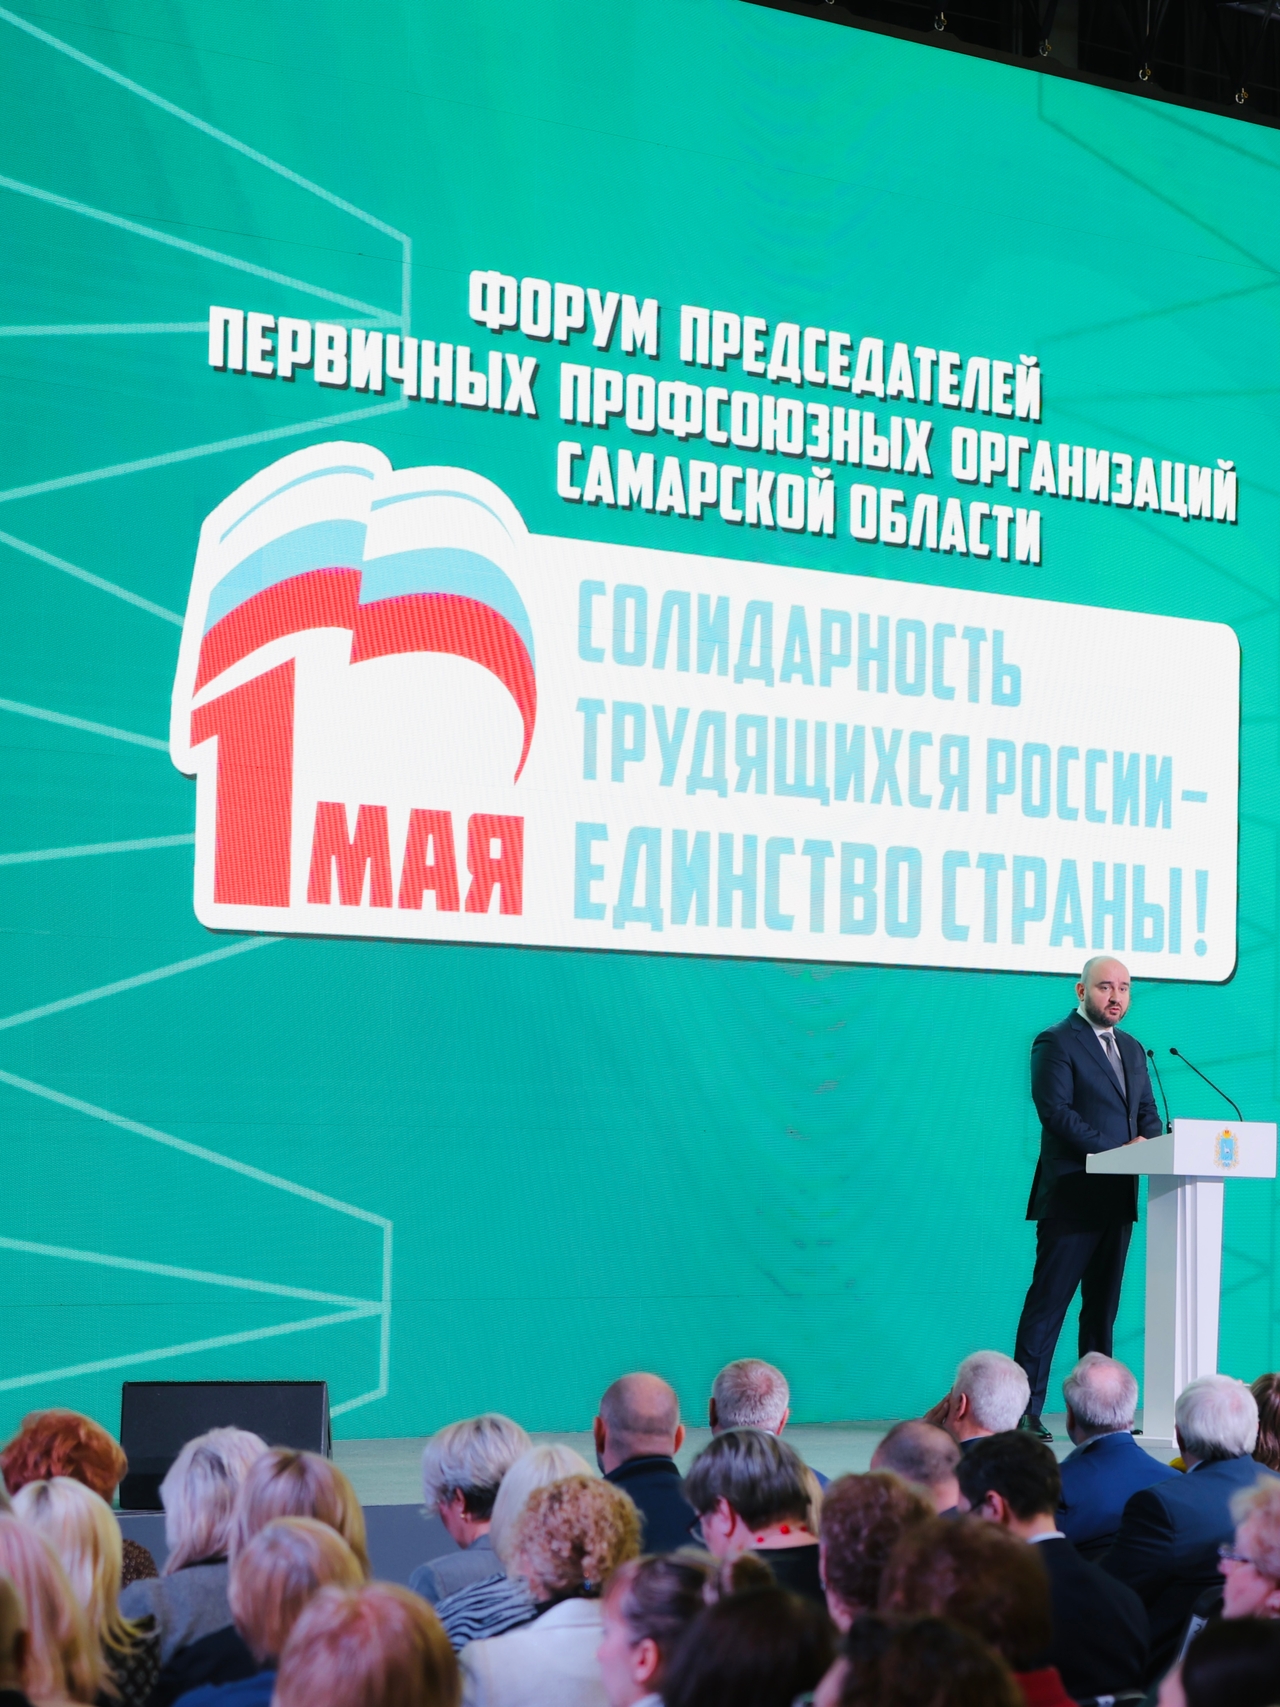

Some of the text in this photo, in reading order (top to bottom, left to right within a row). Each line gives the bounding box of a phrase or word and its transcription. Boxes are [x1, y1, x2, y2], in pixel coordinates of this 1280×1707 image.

[208, 305, 1238, 523] ПЕРВИЧНЫХ ПРОФСОЮЗНЫХ ОРГАНИЗАЦИЙ
[468, 269, 1042, 421] ФОРУМ ПРЕДСЕДАТЕЛЕЙ
[557, 440, 1042, 564] САМАРСКОЙ ОБЛАСТИ
[576, 579, 1022, 708] СОЛИДАРНОСТЬ
[190, 656, 525, 916] 1 МАЯ
[575, 697, 970, 814] ТРУДЯЩИХСЯ
[573, 820, 1210, 958] ЕДИНСТВО СТРАНЫ!
